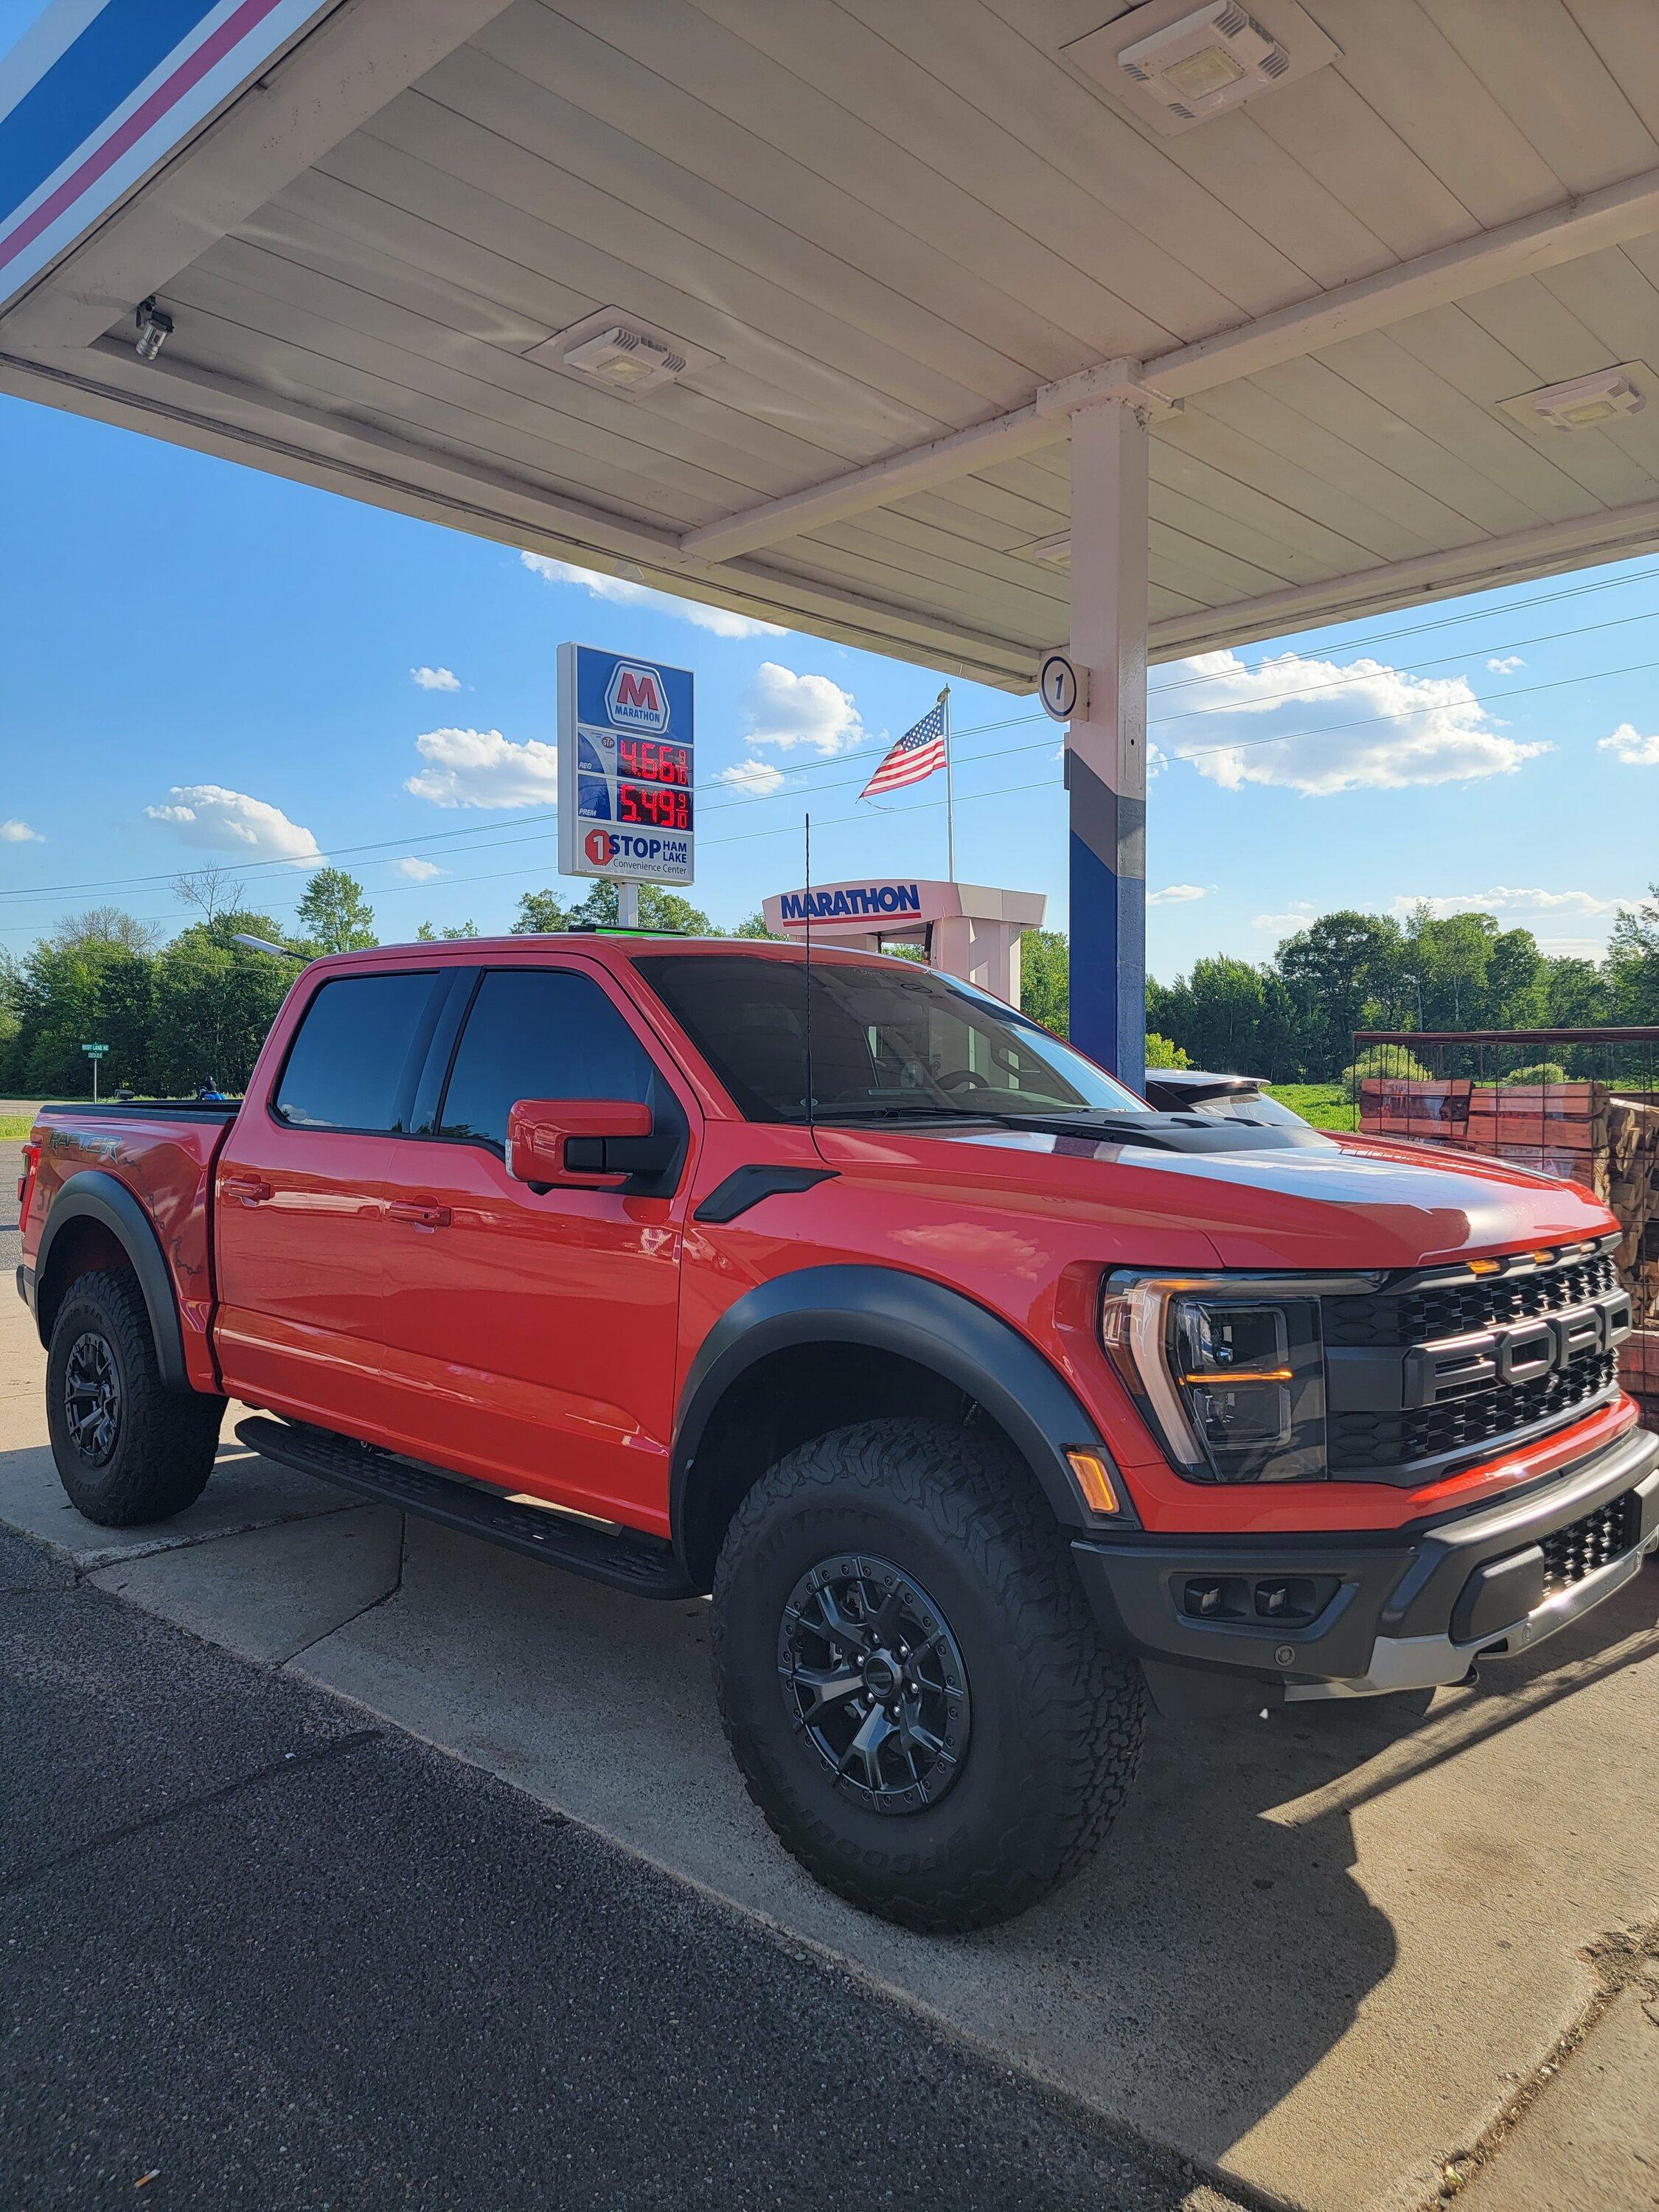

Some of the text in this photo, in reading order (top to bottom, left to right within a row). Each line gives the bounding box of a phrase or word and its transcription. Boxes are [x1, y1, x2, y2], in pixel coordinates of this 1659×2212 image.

[617, 672, 659, 711] M
[1055, 673, 1064, 700] 1
[615, 705, 660, 723] MARATHON
[579, 762, 592, 770] REG
[579, 808, 597, 817] PREM
[620, 784, 675, 827] 5.49
[593, 834, 661, 860] 1 STOP
[663, 840, 687, 853] HAM
[663, 851, 687, 863] LAKE
[613, 858, 687, 875] Convenience Center
[780, 884, 920, 919] MARATHON
[48, 1130, 122, 1165] RAPTOR
[1402, 1287, 1632, 1410] FORD
